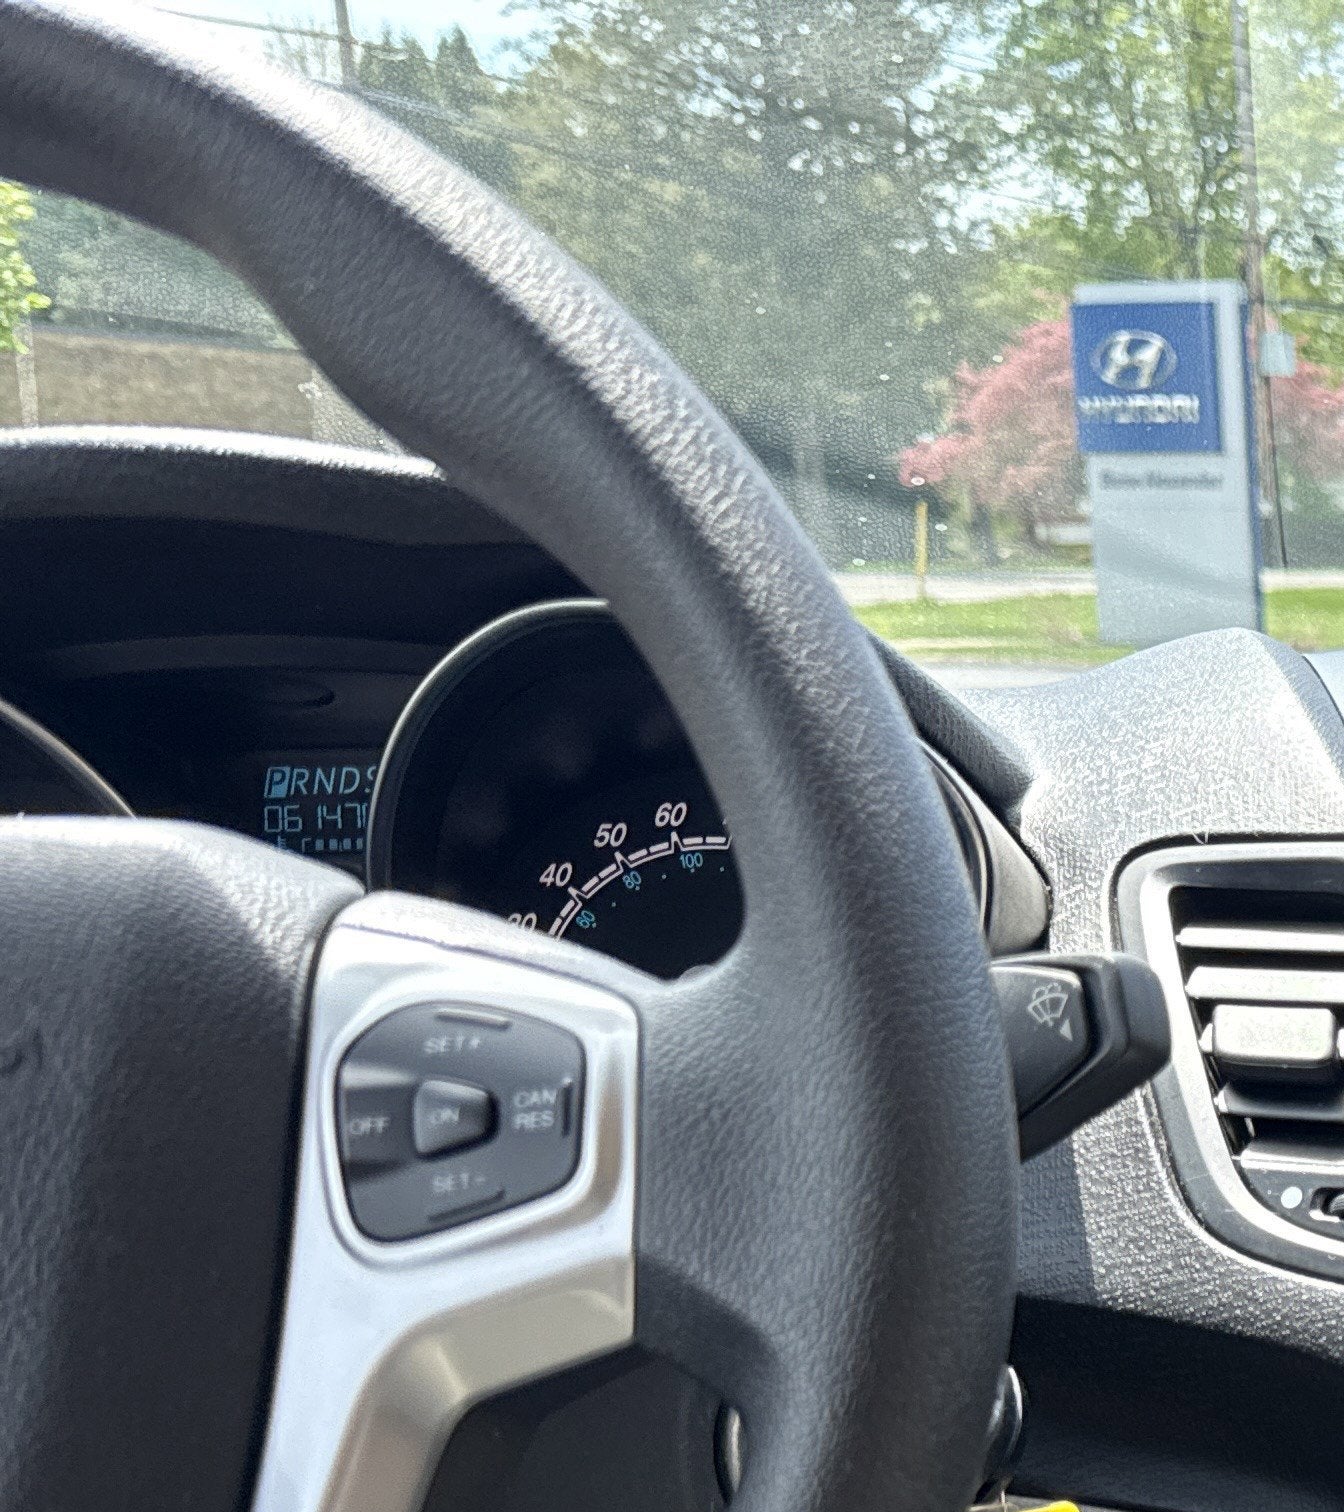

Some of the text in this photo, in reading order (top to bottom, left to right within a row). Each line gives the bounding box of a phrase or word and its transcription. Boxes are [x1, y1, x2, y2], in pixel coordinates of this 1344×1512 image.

[655, 803, 687, 827] 60
[593, 823, 628, 848] 50
[679, 852, 704, 869] 100
[538, 862, 573, 887] 40
[622, 870, 642, 889] 80
[513, 1089, 557, 1108] CAN
[350, 1116, 390, 1136] OFF
[513, 1110, 555, 1130] RES
